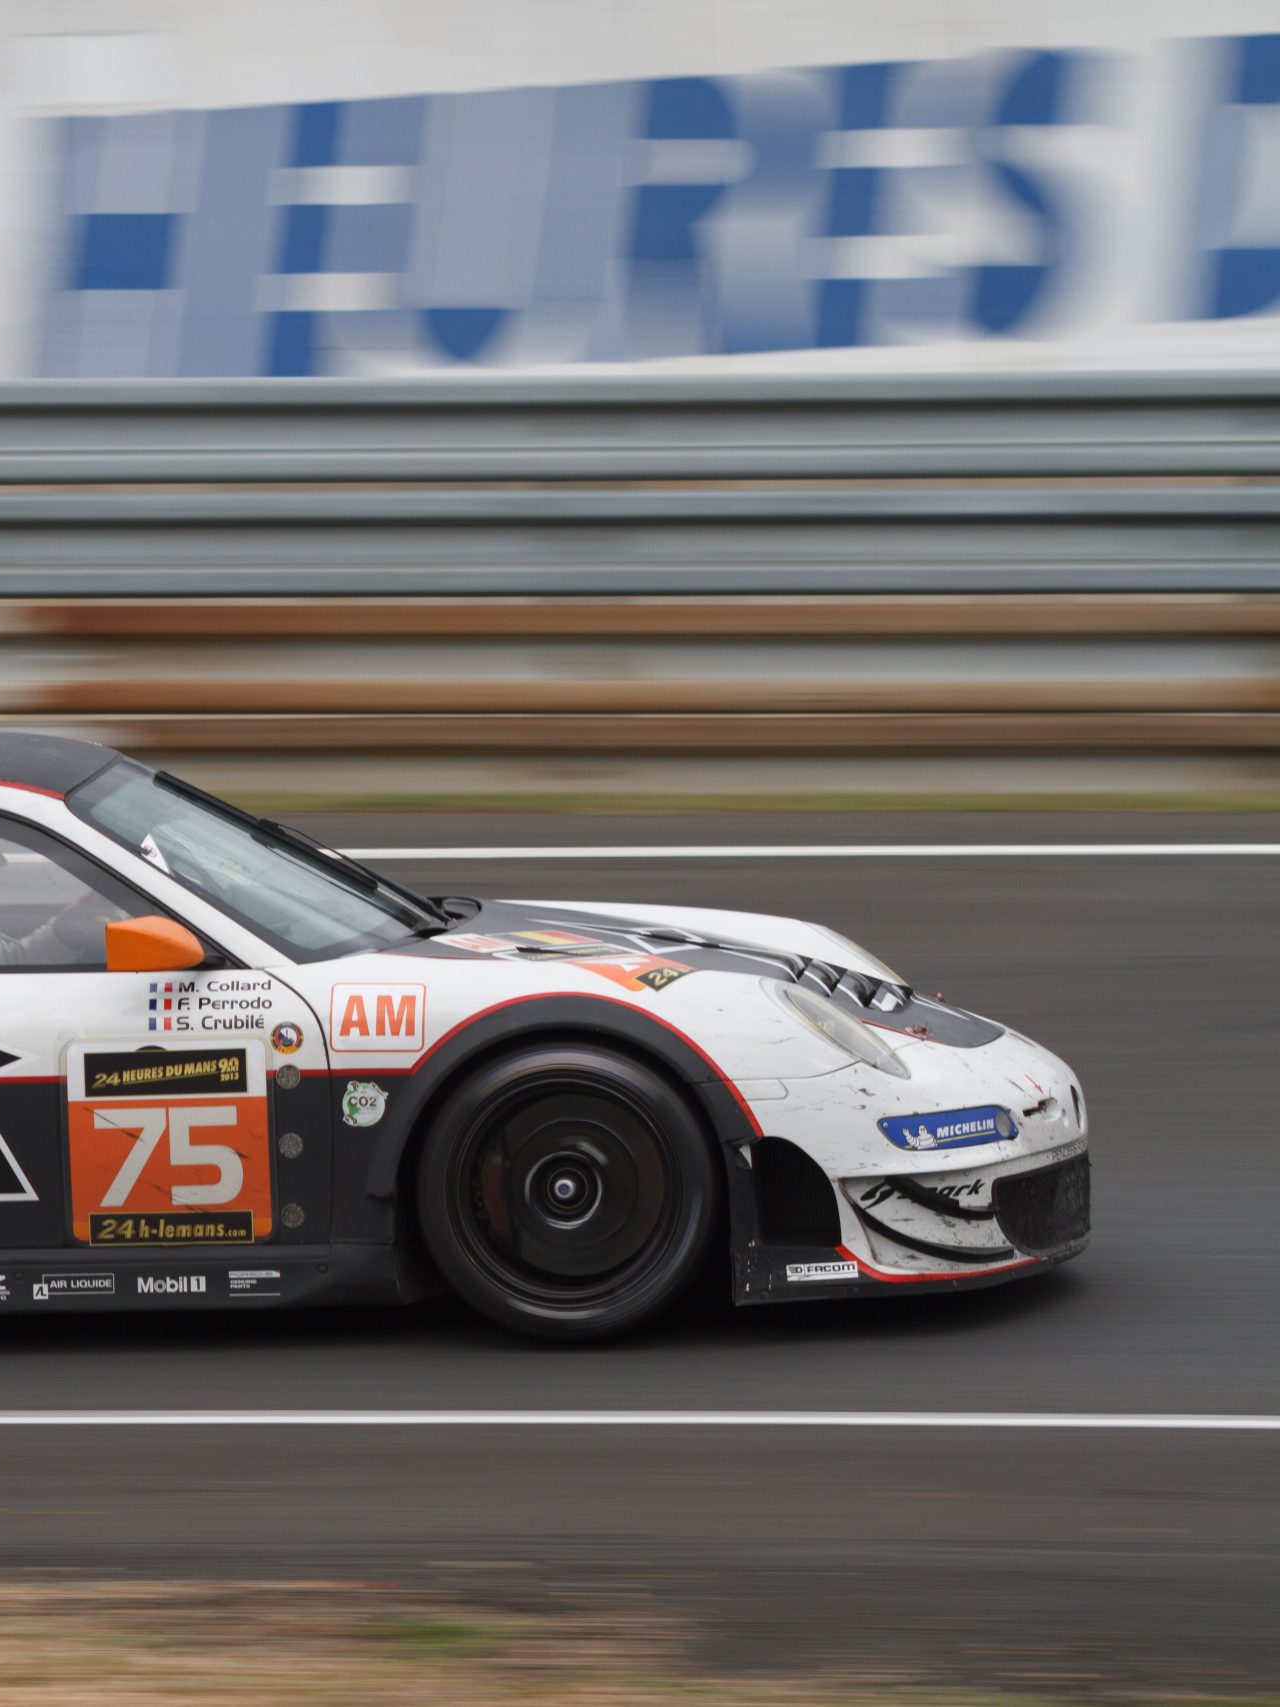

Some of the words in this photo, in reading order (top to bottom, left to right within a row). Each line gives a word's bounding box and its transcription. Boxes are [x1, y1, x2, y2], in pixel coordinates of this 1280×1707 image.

[40, 48, 1120, 378] HEURES
[178, 981, 199, 993] M.
[206, 980, 272, 992] Collard
[177, 998, 191, 1011] F.
[198, 997, 273, 1010] Perrodo
[176, 1017, 195, 1031] S.
[201, 1015, 265, 1030] Crubilé
[338, 994, 417, 1037] AM
[92, 1071, 121, 1089] 24
[122, 1066, 164, 1083] HEURES
[165, 1064, 183, 1078] DU
[184, 1060, 217, 1075] MANS
[220, 1072, 239, 1082] 2013
[348, 1095, 377, 1108] CO2
[936, 1118, 995, 1138] MICHELIN
[93, 1105, 244, 1207] 75
[807, 1263, 855, 1273] FACOM
[49, 1280, 67, 1289] AIR
[70, 1278, 112, 1289] LIQUIDE
[137, 1276, 188, 1293] Mobil
